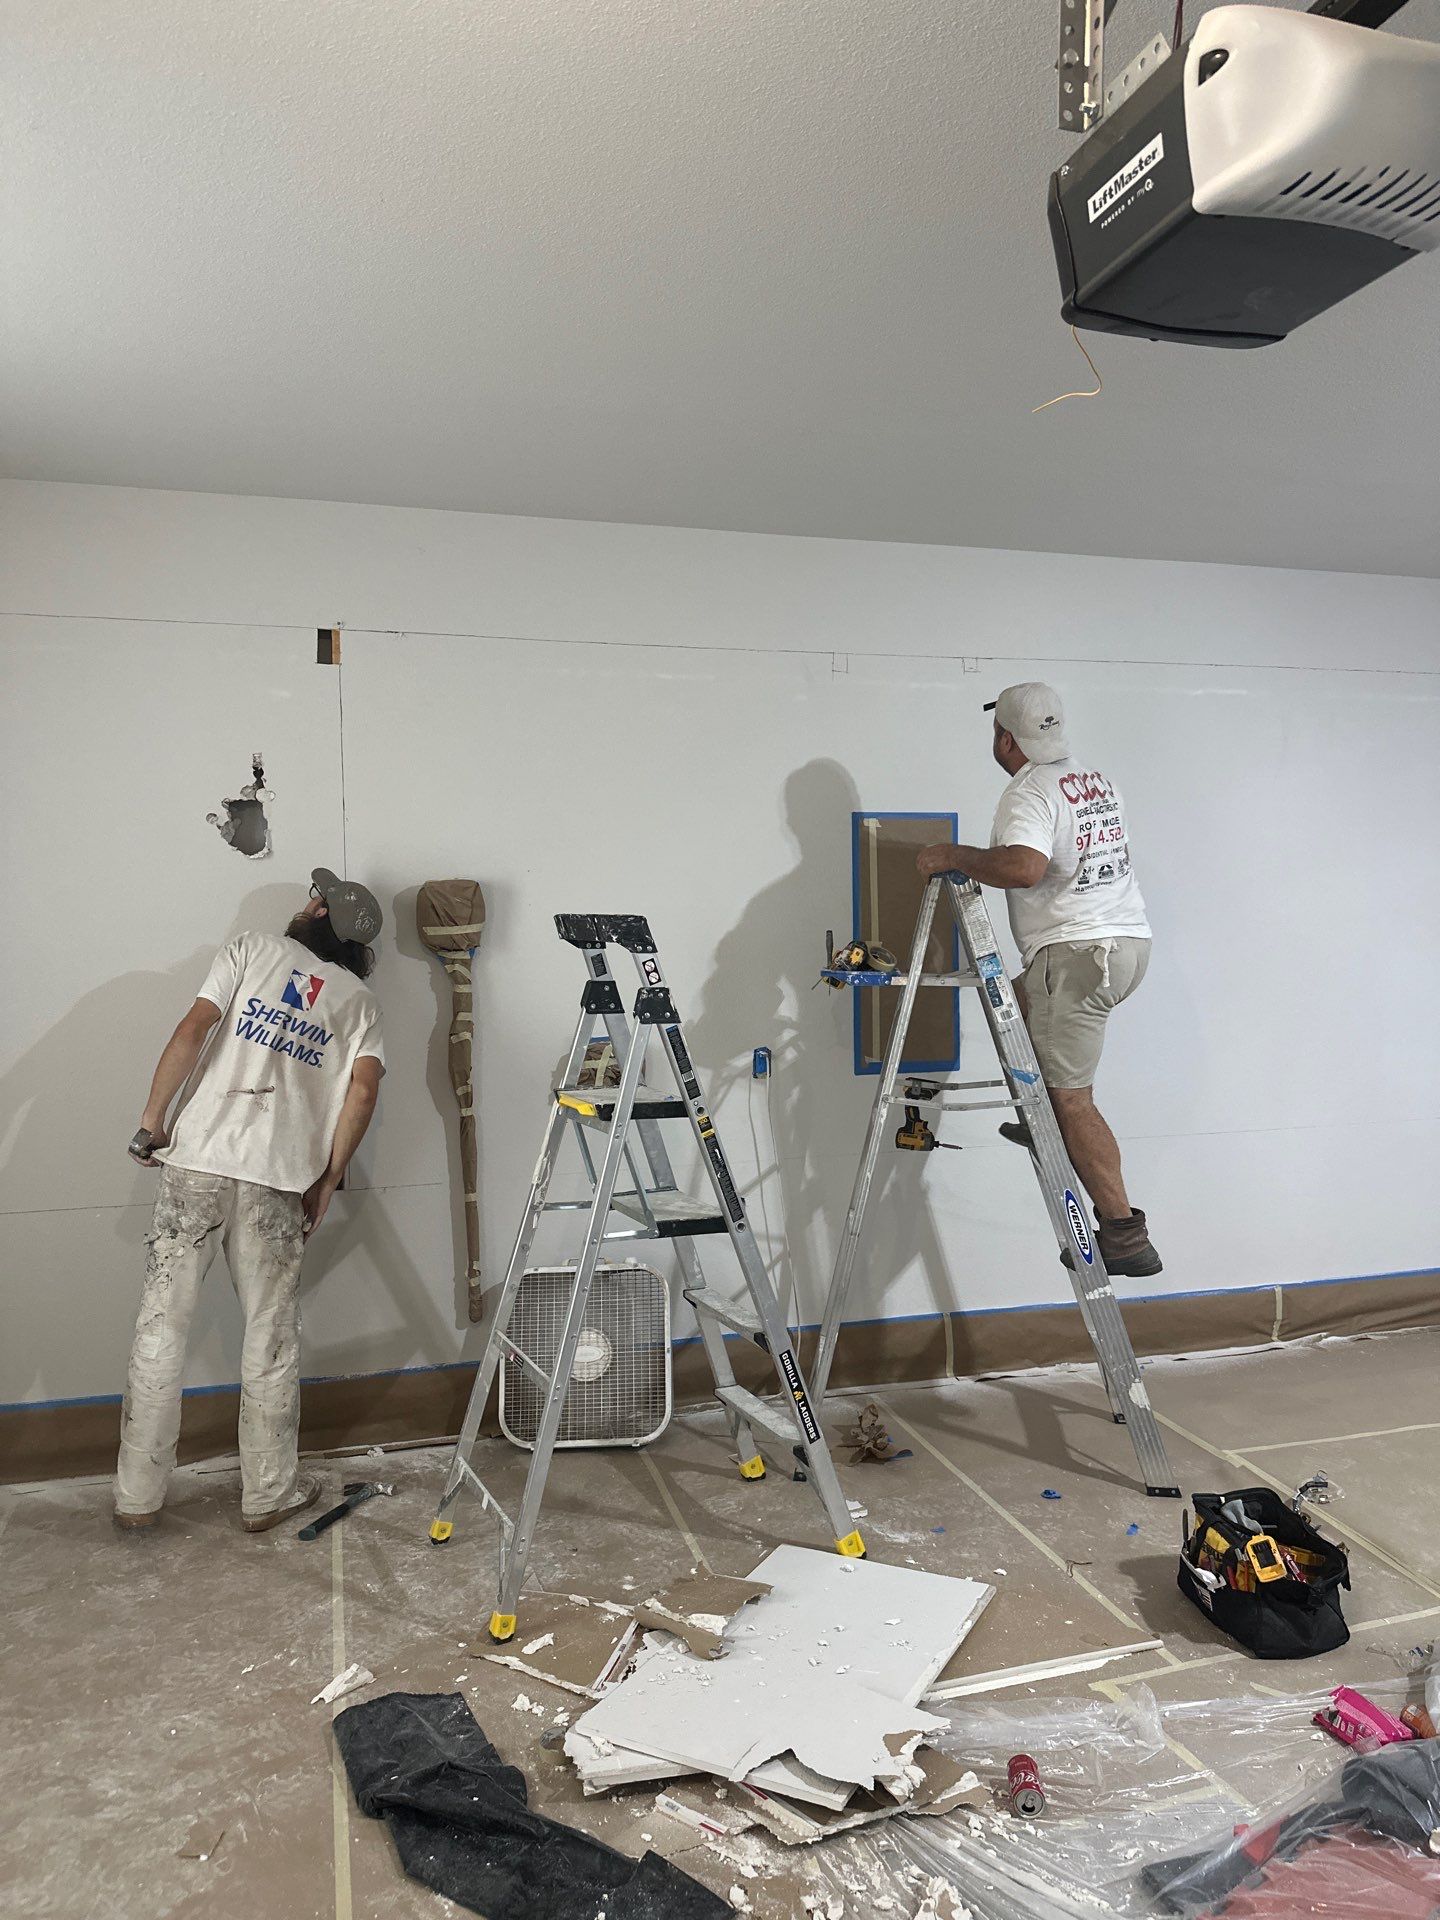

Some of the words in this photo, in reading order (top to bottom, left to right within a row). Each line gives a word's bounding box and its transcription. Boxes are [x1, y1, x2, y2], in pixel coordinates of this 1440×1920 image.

[1092, 147, 1158, 215] LiftMaster
[1136, 178, 1154, 199] myQ
[235, 1017, 324, 1067] WILLIAMS
[241, 997, 334, 1046] SHERWIN
[1069, 1204, 1089, 1251] WERNER
[781, 1352, 799, 1389] GORILLA
[798, 1400, 817, 1439] LADDERS
